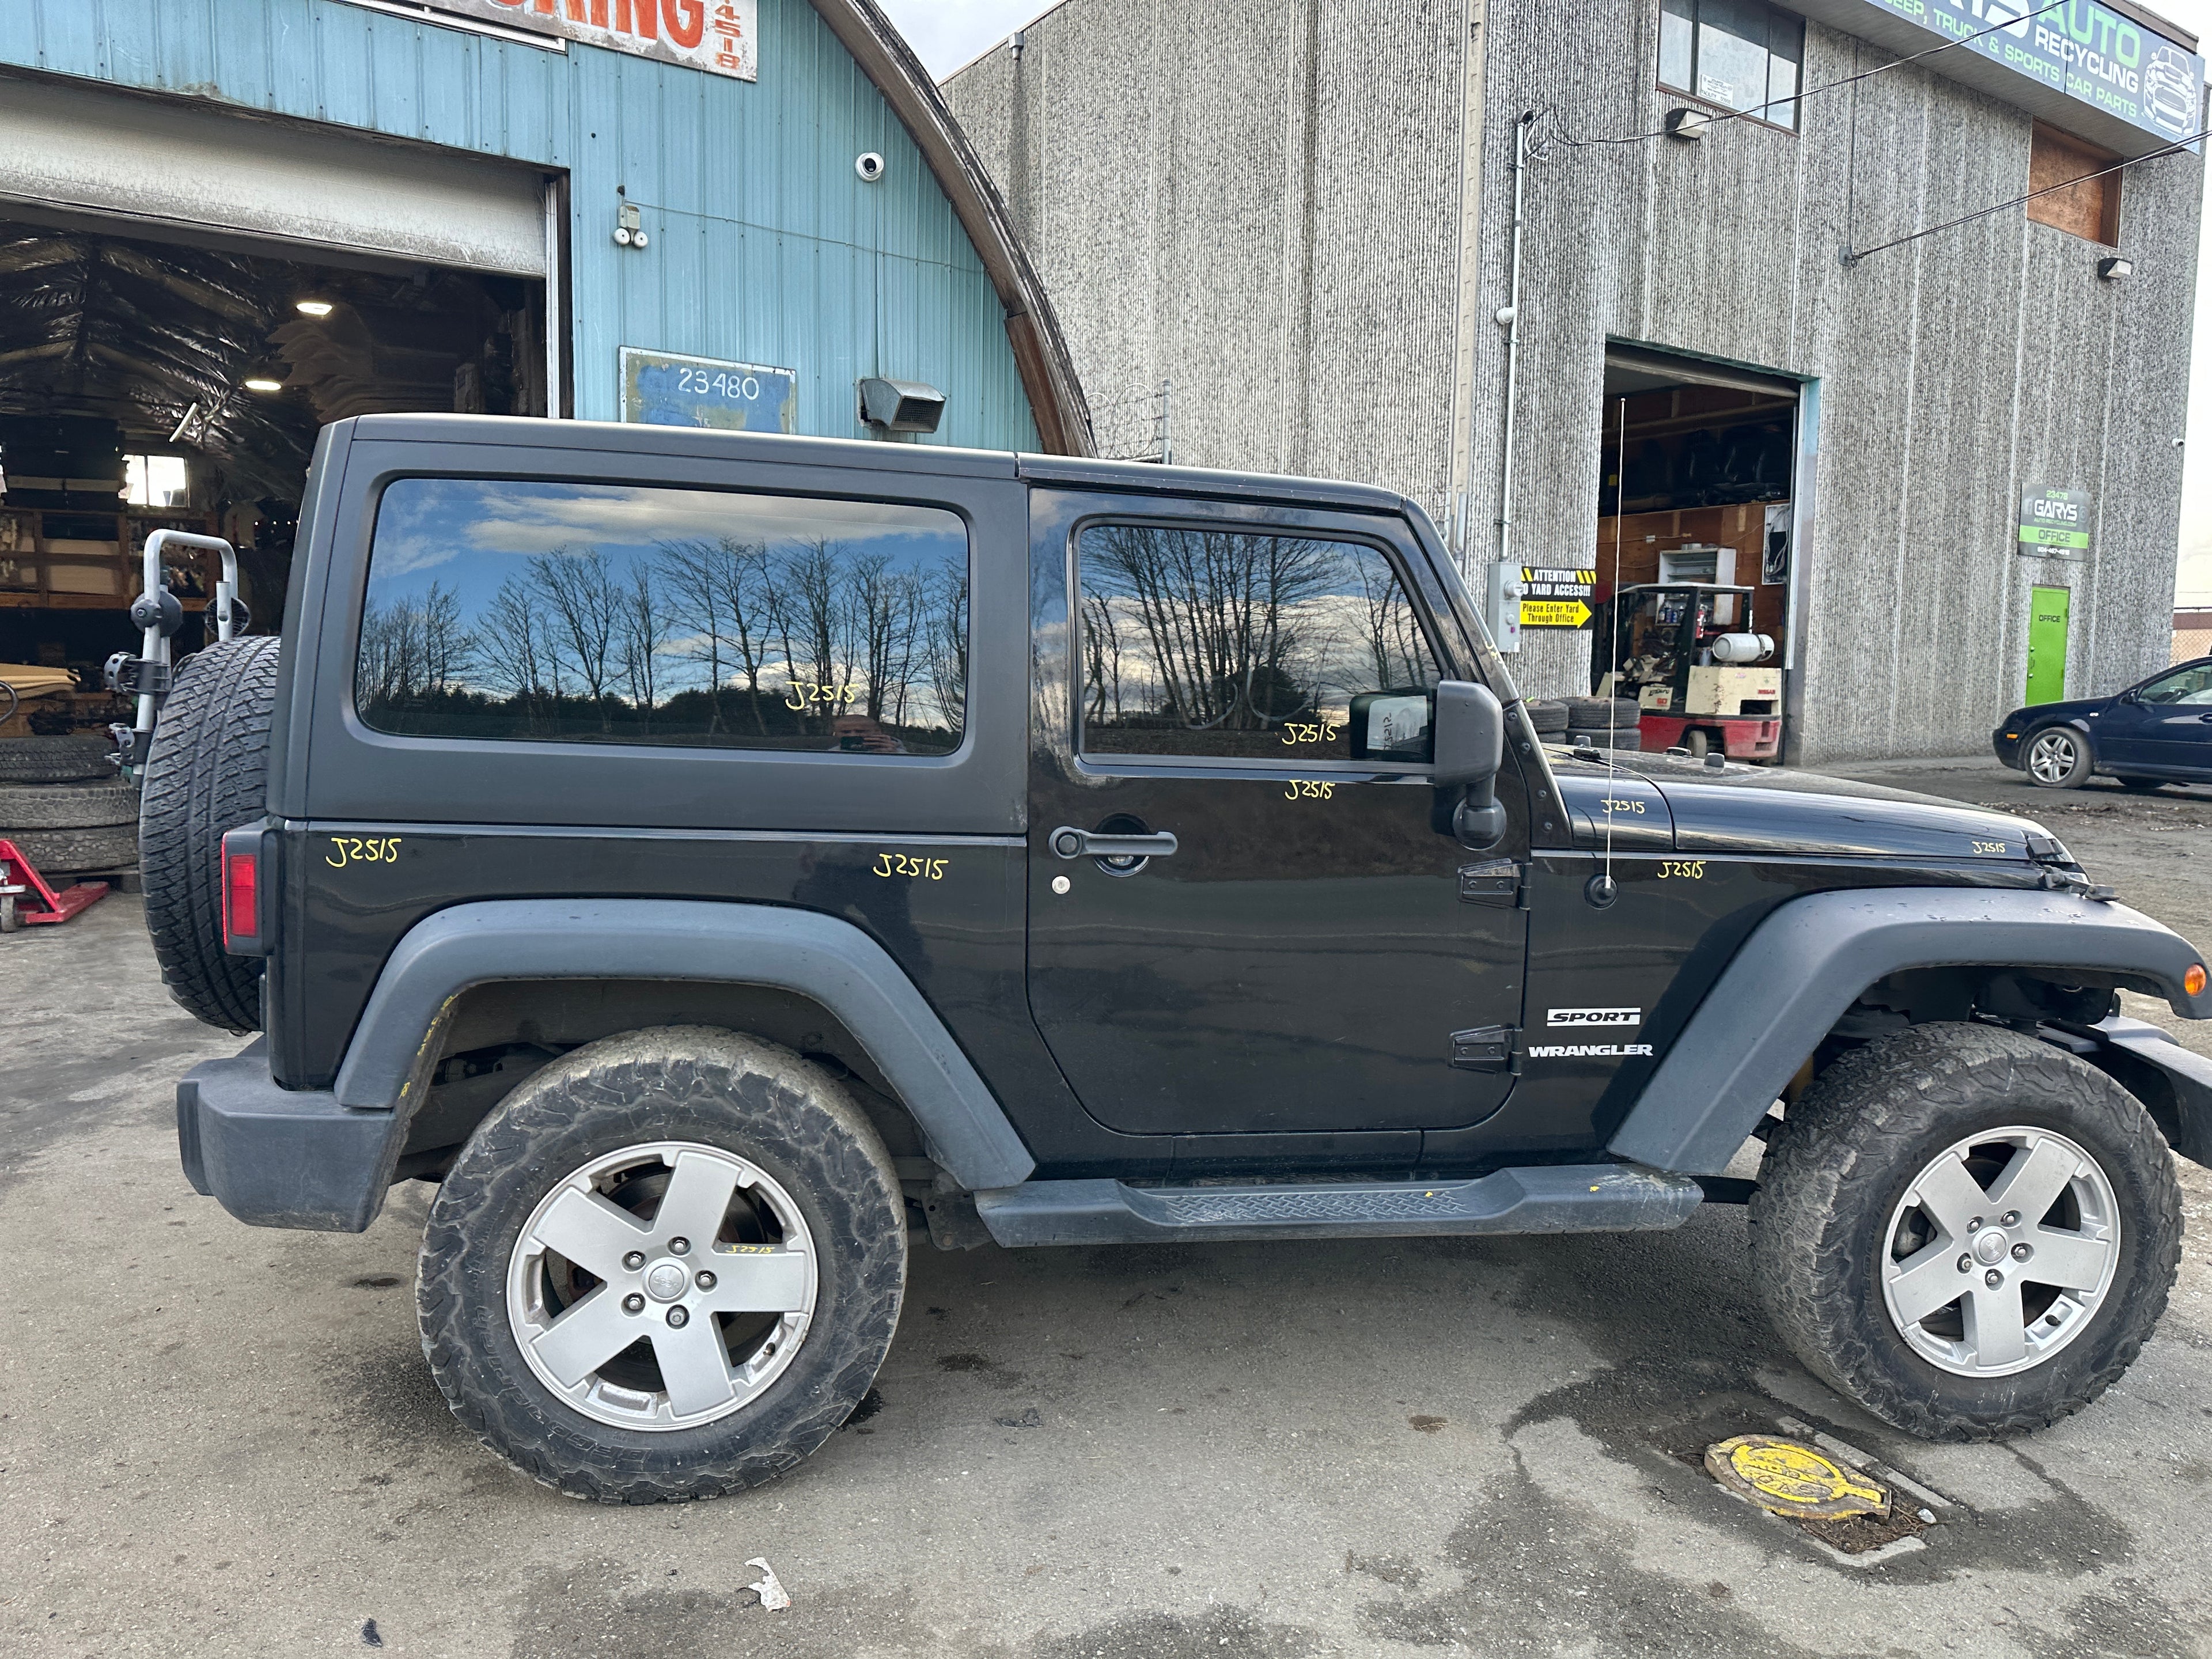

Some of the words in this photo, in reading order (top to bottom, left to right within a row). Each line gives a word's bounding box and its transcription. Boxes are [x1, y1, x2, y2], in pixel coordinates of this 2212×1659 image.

[2037, 0, 2141, 69] AUTO
[1884, 0, 1927, 24] EEP,
[1933, 8, 1983, 47] TRUCK
[1988, 36, 1999, 55] &
[2005, 43, 2060, 82] SPORTS
[2066, 72, 2092, 97] CAR
[2096, 87, 2137, 118] PARTS
[2035, 24, 2139, 93] RECYCLING
[677, 368, 760, 400] 23480
[2046, 490, 2068, 501] 23478
[2034, 499, 2078, 521] GARYS
[2039, 529, 2071, 542] OFFICE
[1533, 569, 1576, 582] ATTENTION
[1532, 584, 1551, 595] YARD
[1554, 584, 1590, 596] ACCESS!!!
[1522, 603, 1543, 612] Please
[1546, 604, 1563, 613] Enter
[1566, 604, 1579, 613] Yard
[1528, 613, 1552, 623] Through
[1555, 613, 1574, 623] Office
[2039, 614, 2061, 623] OFFICE
[785, 681, 860, 710] J2515
[1282, 723, 1340, 745] J2515
[1285, 779, 1335, 800] J2515
[1600, 800, 1645, 814] J2515
[325, 837, 402, 868] J2515
[1972, 841, 2006, 854] J2515
[873, 853, 949, 880] J2515
[1657, 860, 1707, 880] J2515
[1548, 1011, 1640, 1024] SPORT
[1528, 1044, 1654, 1058] WRANGLER
